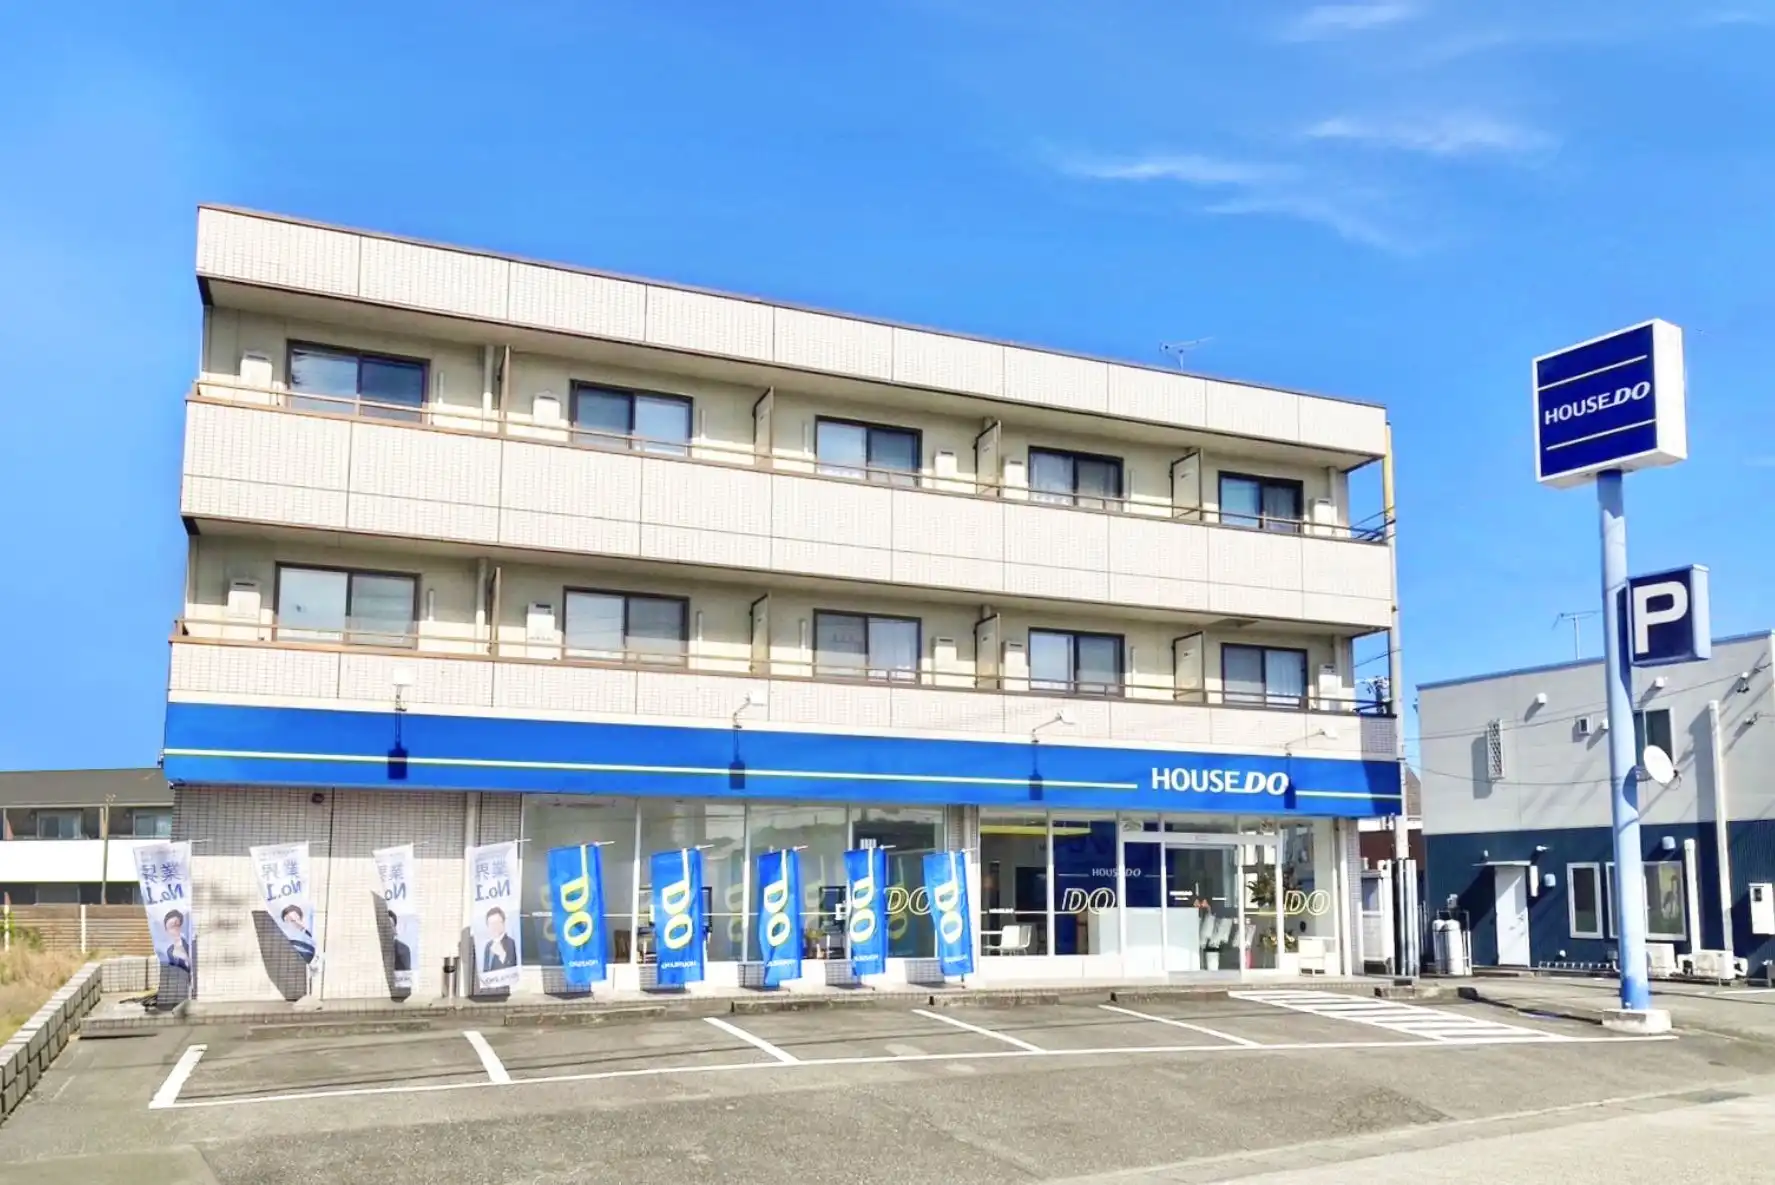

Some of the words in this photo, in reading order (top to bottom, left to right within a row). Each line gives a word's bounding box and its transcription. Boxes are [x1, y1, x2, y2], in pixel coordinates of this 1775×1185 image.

[1632, 580, 1689, 654] P
[1092, 867, 1141, 878] HOUSDO
[1061, 887, 1116, 915] DO
[1284, 889, 1331, 916] DO
